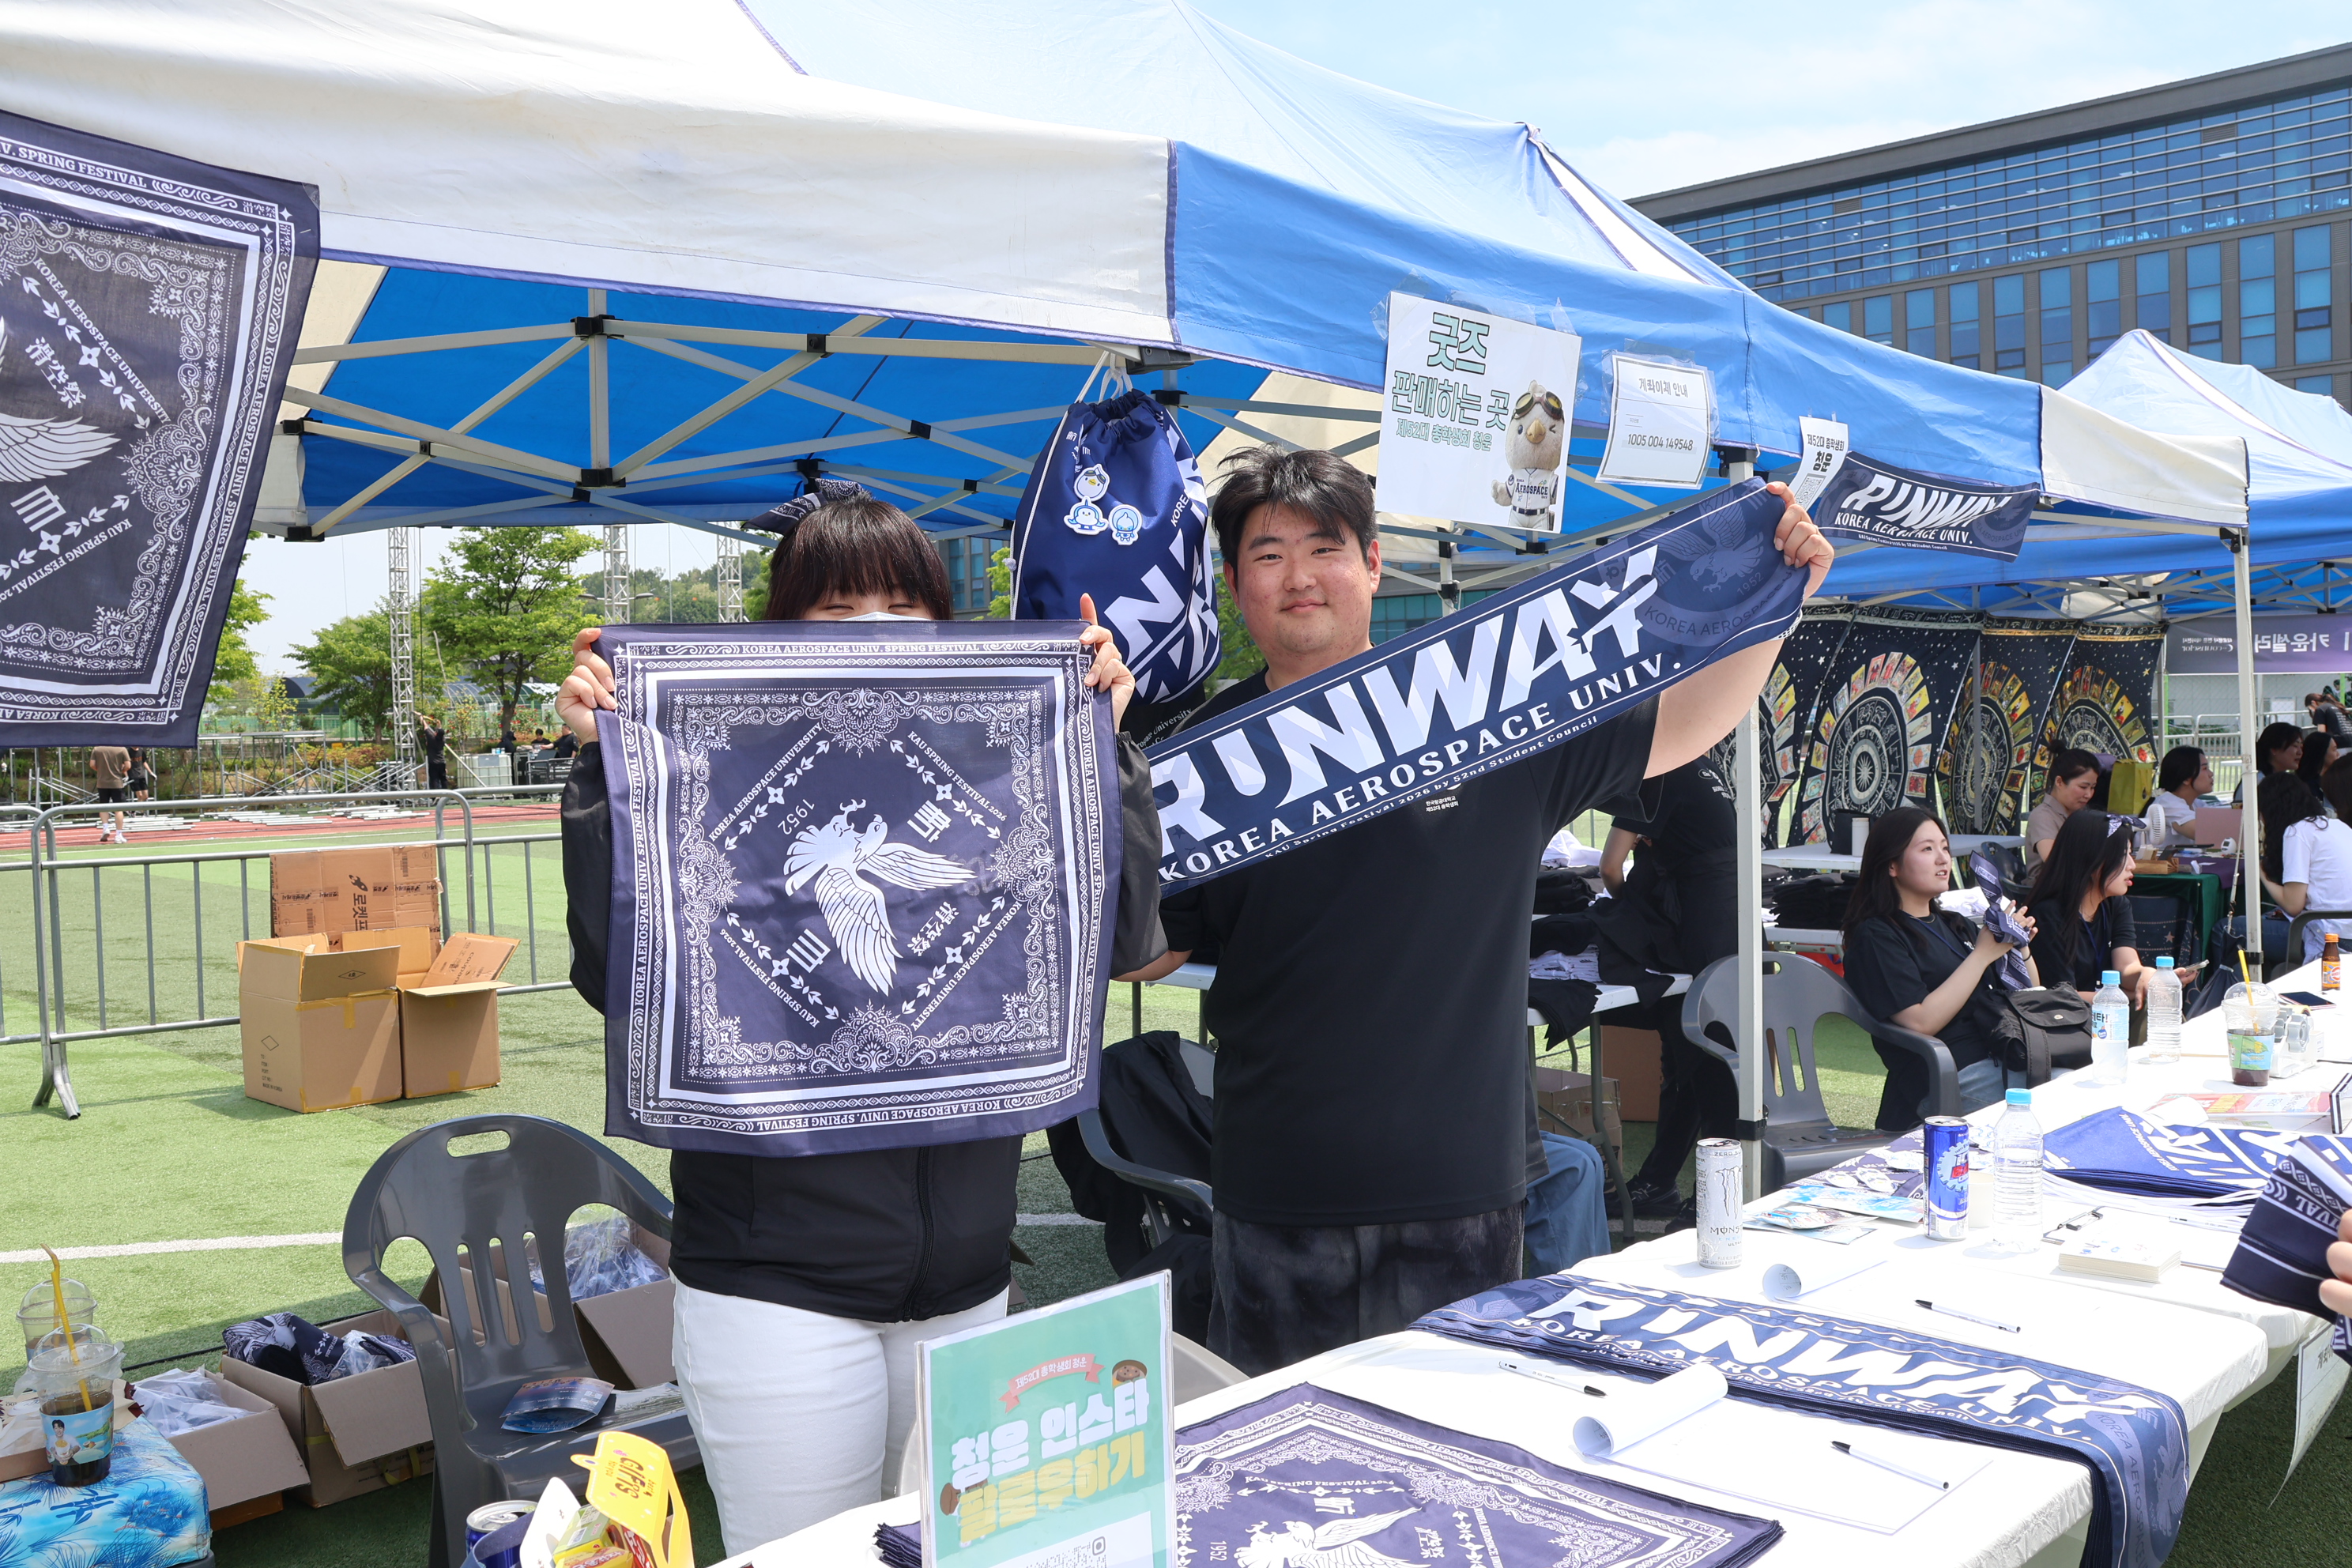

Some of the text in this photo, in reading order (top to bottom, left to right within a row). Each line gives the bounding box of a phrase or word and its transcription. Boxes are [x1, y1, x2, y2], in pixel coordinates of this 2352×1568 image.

[18, 147, 76, 171] SPRING
[77, 161, 148, 189] FESTIVAL
[33, 257, 172, 424] KOREA AEROSPACE UNIVERSITY
[1427, 311, 1491, 375] 굿즈
[1392, 370, 1510, 431] 판매하는 곳
[1638, 378, 1689, 398] 계좌이체 안내
[1396, 418, 1493, 451] 제52대 총학생회 청운
[1627, 433, 1694, 451] 1005 004 149548
[1807, 434, 1845, 451] 제52대 총학생회
[201, 345, 276, 604] KOREA AEROSPACE UNIV. SPRING FESTIVAL
[1812, 450, 1833, 473] 청운
[1515, 482, 1548, 496] AEROSPACE
[1834, 512, 1869, 530] KOREA
[1939, 529, 1973, 545] UNIV.
[12, 518, 133, 594] KAU SPRING FESTIVAL
[1736, 571, 1765, 597] 1952
[1644, 583, 1785, 636] KOREA AEROSPACE
[741, 643, 981, 655] KOREA AEROSPACE UNIV. SPRING FESTIVAL
[16, 710, 61, 721] KOREA
[1150, 544, 1658, 856] RUNWAY
[1153, 708, 1193, 735] University
[708, 721, 823, 842] KOREA AEROSPACE UNIVERSITY
[906, 730, 1008, 822] KAU SPRING FESTIVAL 2026
[1158, 652, 1683, 883] KOREA AEROSPACE UNIV.
[1293, 827, 1338, 847] Spring
[1340, 801, 1396, 828] Festival
[1397, 787, 1431, 805] 2026
[1434, 778, 1450, 791] by
[1453, 764, 1486, 782] 52nd
[1488, 741, 1544, 769] Student
[1546, 715, 1598, 742] Council
[777, 798, 816, 835] 1952
[1425, 803, 1442, 812] 제52대
[1081, 741, 1102, 973] KOREA AEROSPACE UNIV. SPRING FESTIVAL
[631, 756, 650, 1008] KOREA AEROSPACE UNIV. SPRING FESTIVAL
[994, 900, 1023, 933] KOREA
[719, 928, 737, 948] 2026
[953, 930, 998, 982] AEROSPACE
[733, 944, 771, 986] FESTIVAL
[767, 981, 802, 1012] SPRING
[910, 978, 958, 1032] UNIVERSITY
[798, 1008, 820, 1028] KAU
[756, 1099, 1001, 1132] KOREA AEROSPACE UNIV. SPRING FESTIVAL
[1015, 1356, 1087, 1389] 제52대 총학생회 청운
[1510, 1317, 1643, 1351] KOREA
[1658, 1348, 1939, 1412] AEROSPACE
[1962, 1402, 2094, 1442] UNIV.
[951, 1378, 1150, 1493] 청운 인스타
[959, 1430, 1145, 1544] 팔로우하기
[1245, 1475, 1270, 1485] KAU
[1552, 1480, 1608, 1506] FESTIVAL
[2094, 1413, 2147, 1559] KOREA AEROSPACE
[1209, 1540, 1228, 1562] 1952
